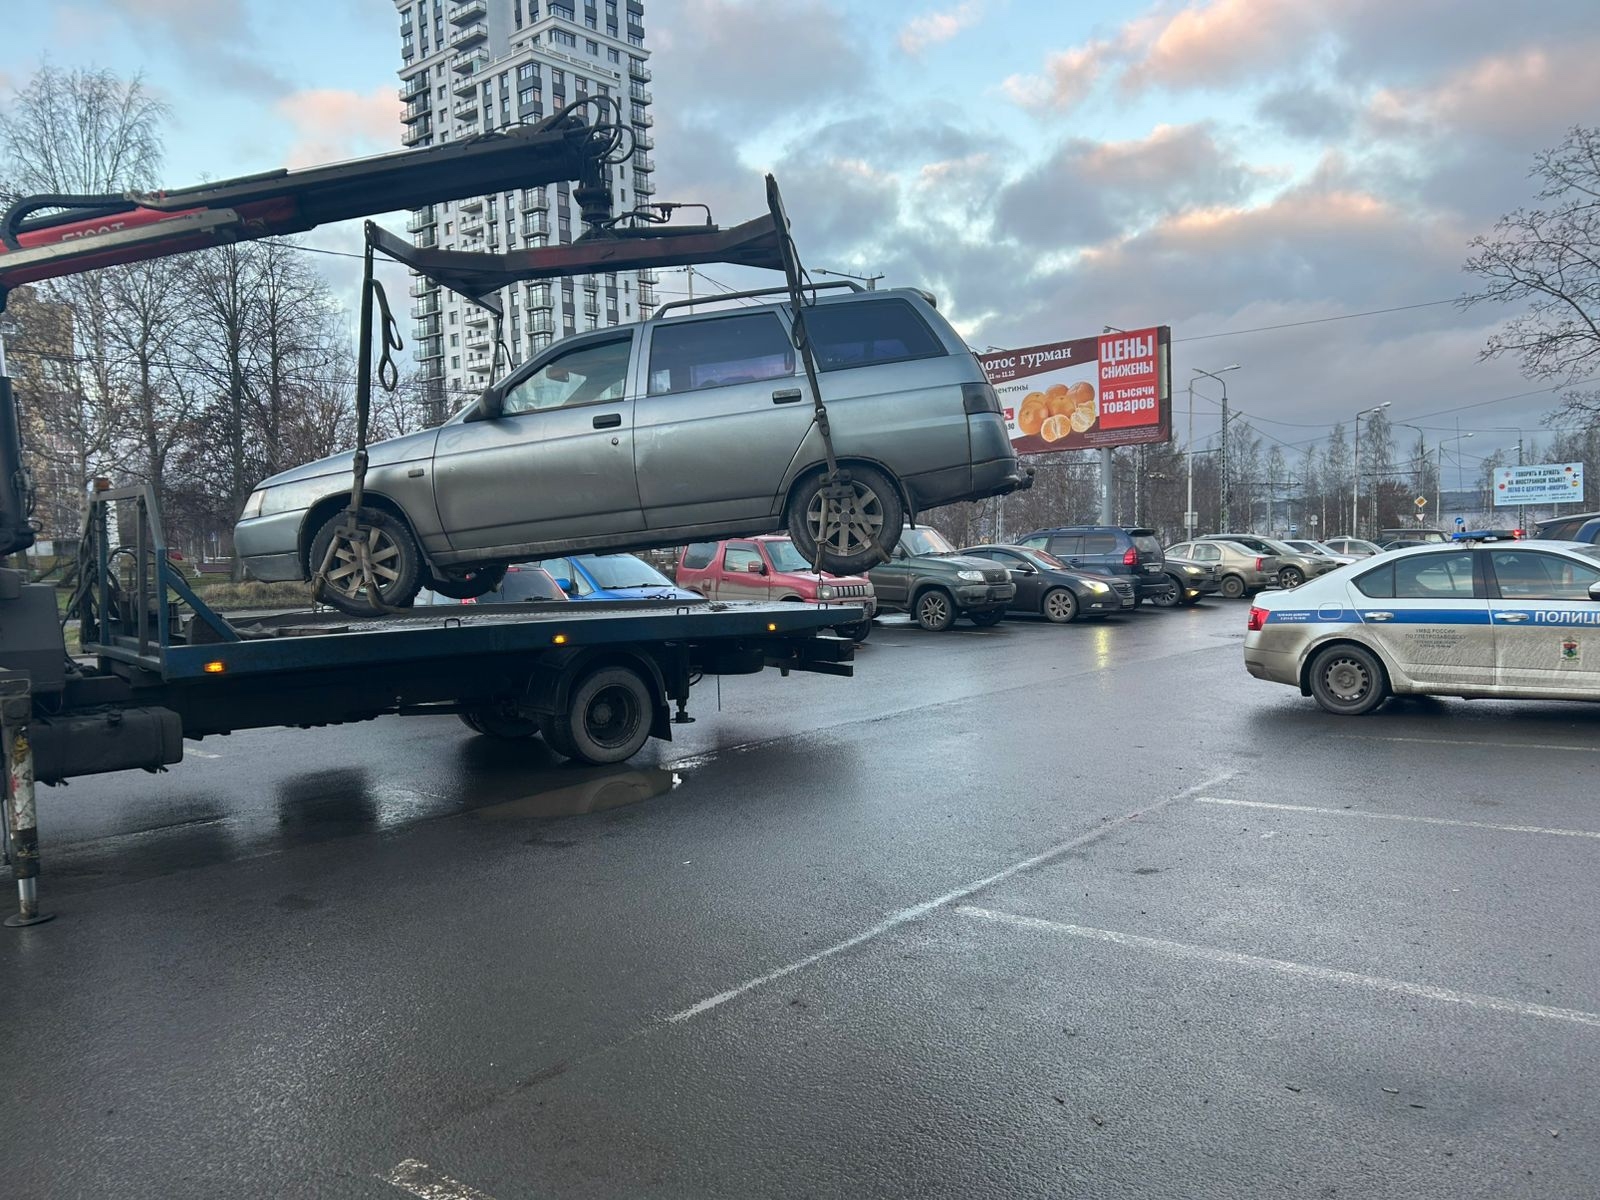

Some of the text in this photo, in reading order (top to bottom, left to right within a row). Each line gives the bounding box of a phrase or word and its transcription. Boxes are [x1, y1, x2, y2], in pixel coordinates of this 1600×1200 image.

[1020, 347, 1072, 367] гурман
[1101, 335, 1153, 365] ЦЕНЫ
[1102, 361, 1153, 379] СНИЖЕНЫ
[1103, 386, 1154, 400] на тысячи
[1102, 398, 1154, 414] товаров
